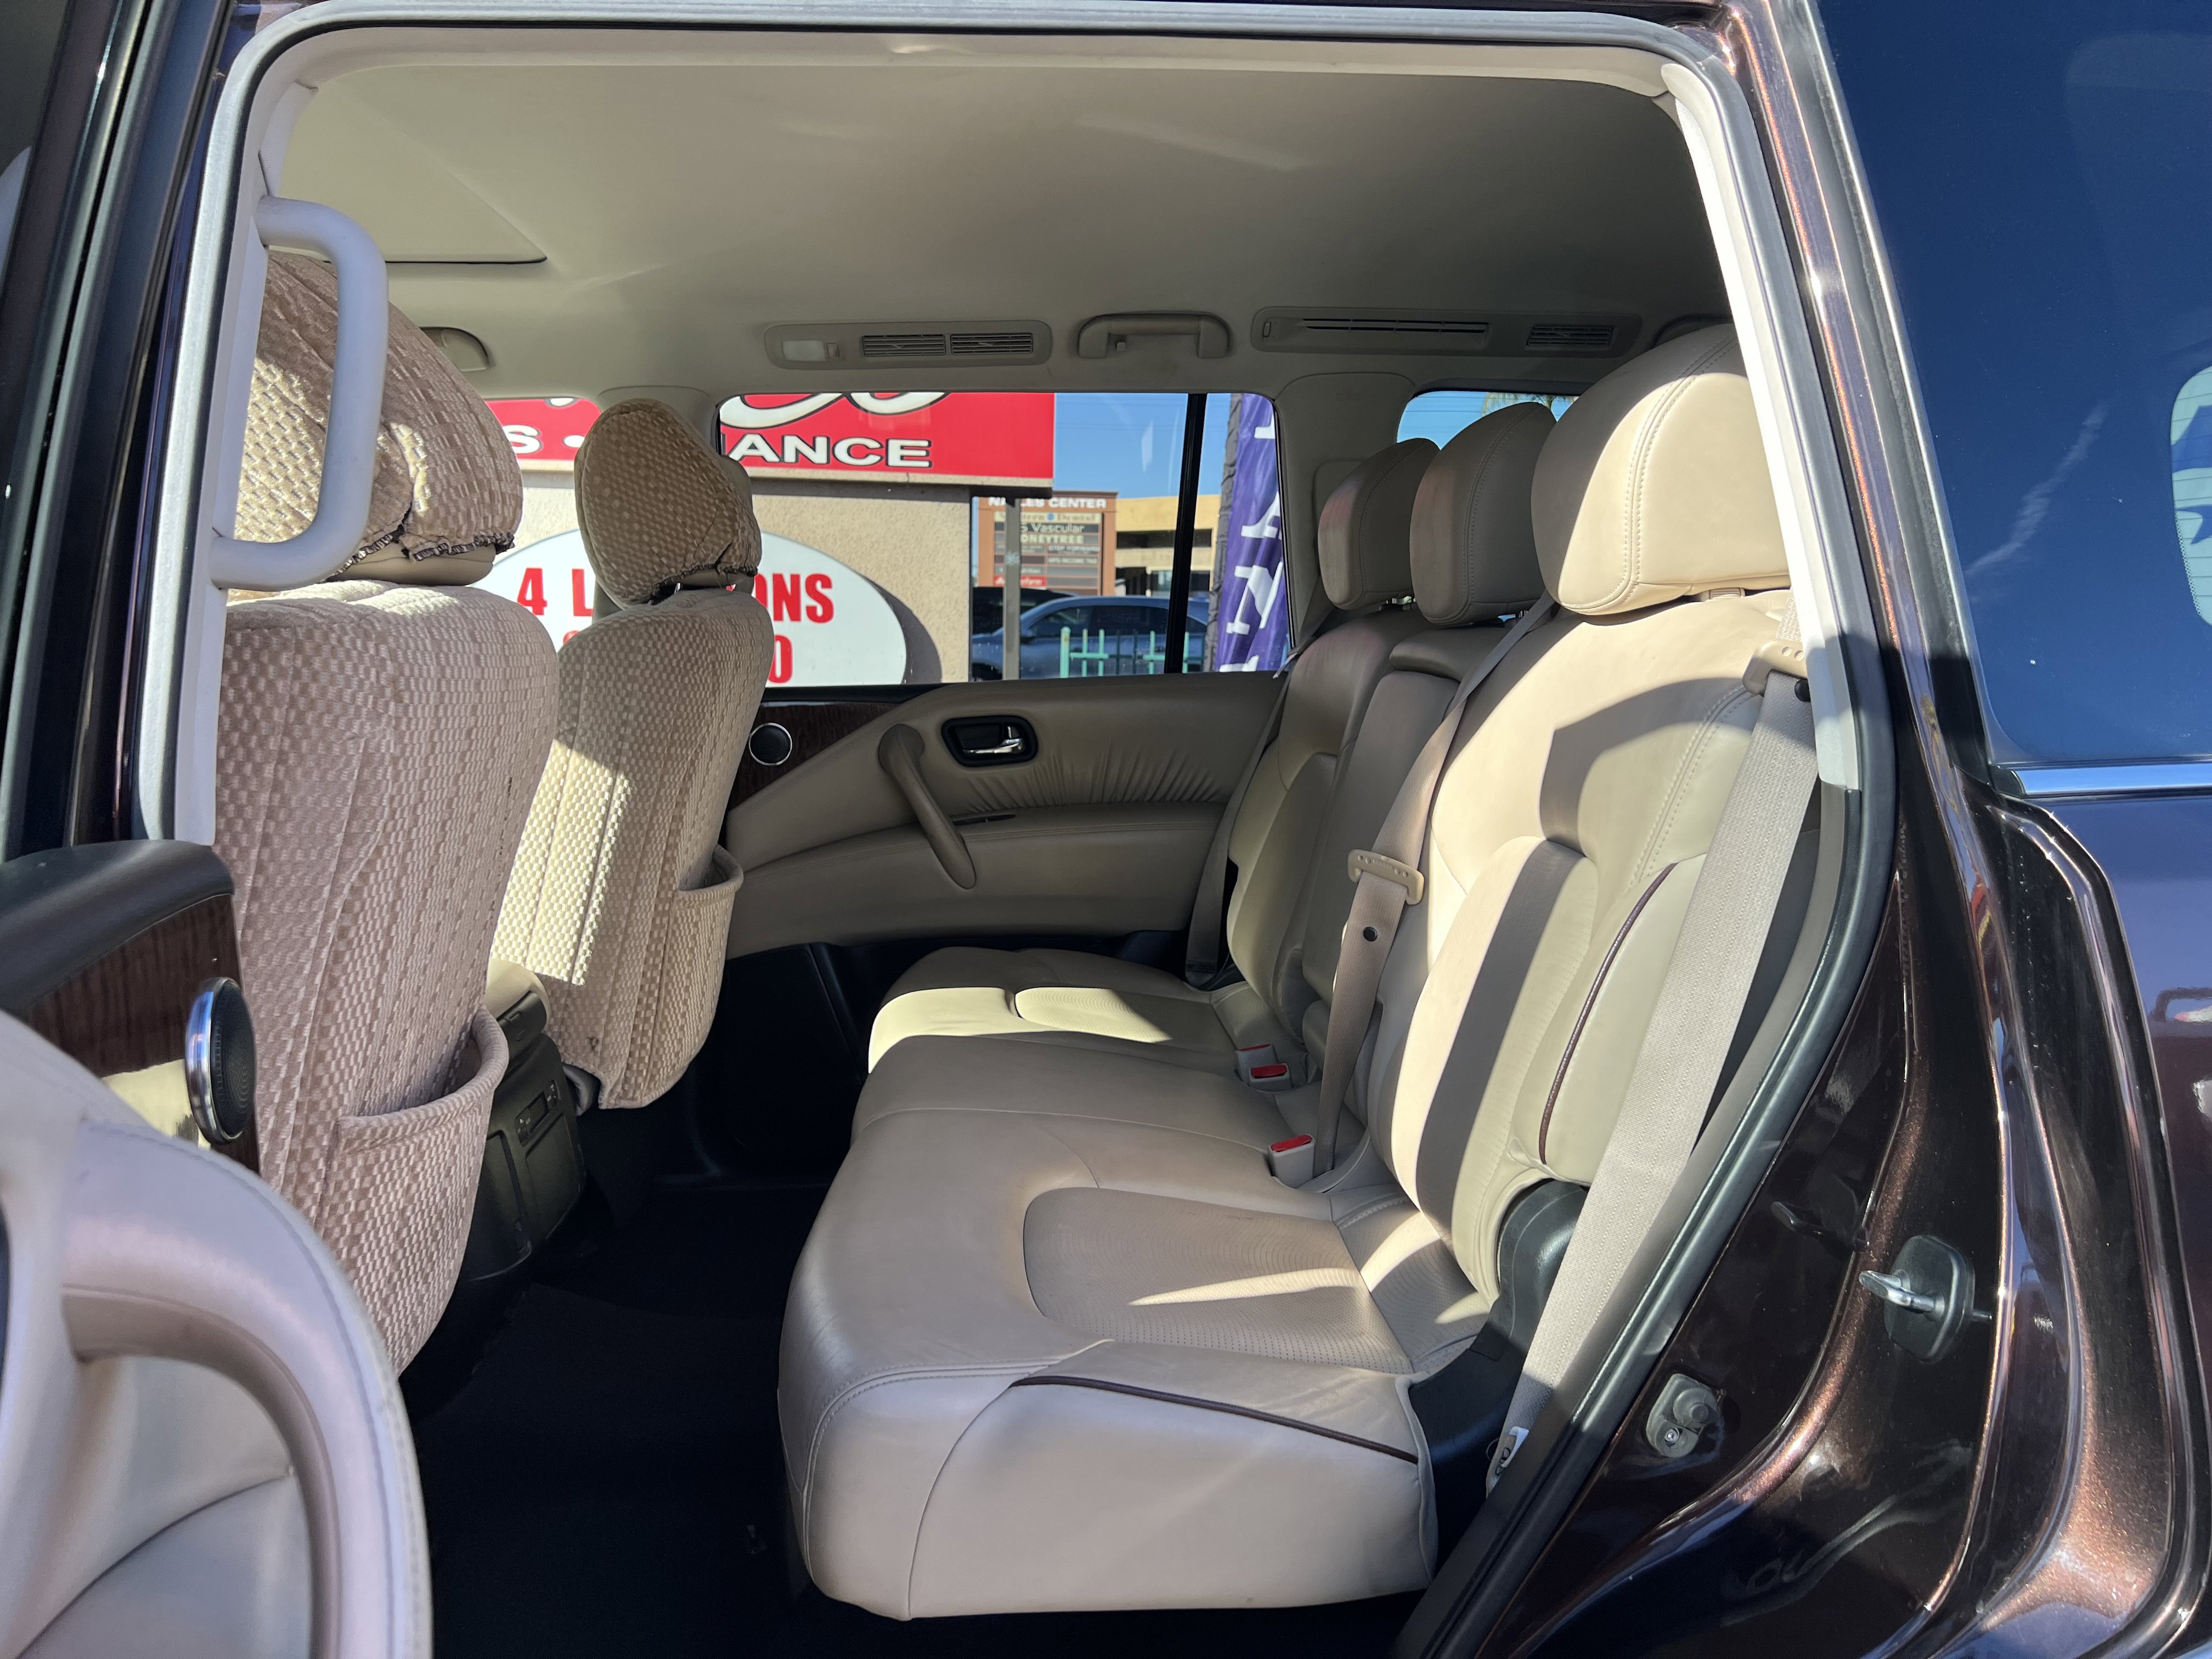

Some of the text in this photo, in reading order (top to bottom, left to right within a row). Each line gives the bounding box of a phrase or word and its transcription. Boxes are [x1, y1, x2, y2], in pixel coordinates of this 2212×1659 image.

[721, 433, 933, 468] ANCE
[1048, 498, 1107, 509] CENTER
[1031, 522, 1085, 532] Vascular
[1020, 534, 1084, 544] ONEYTREE
[517, 567, 548, 616] 4
